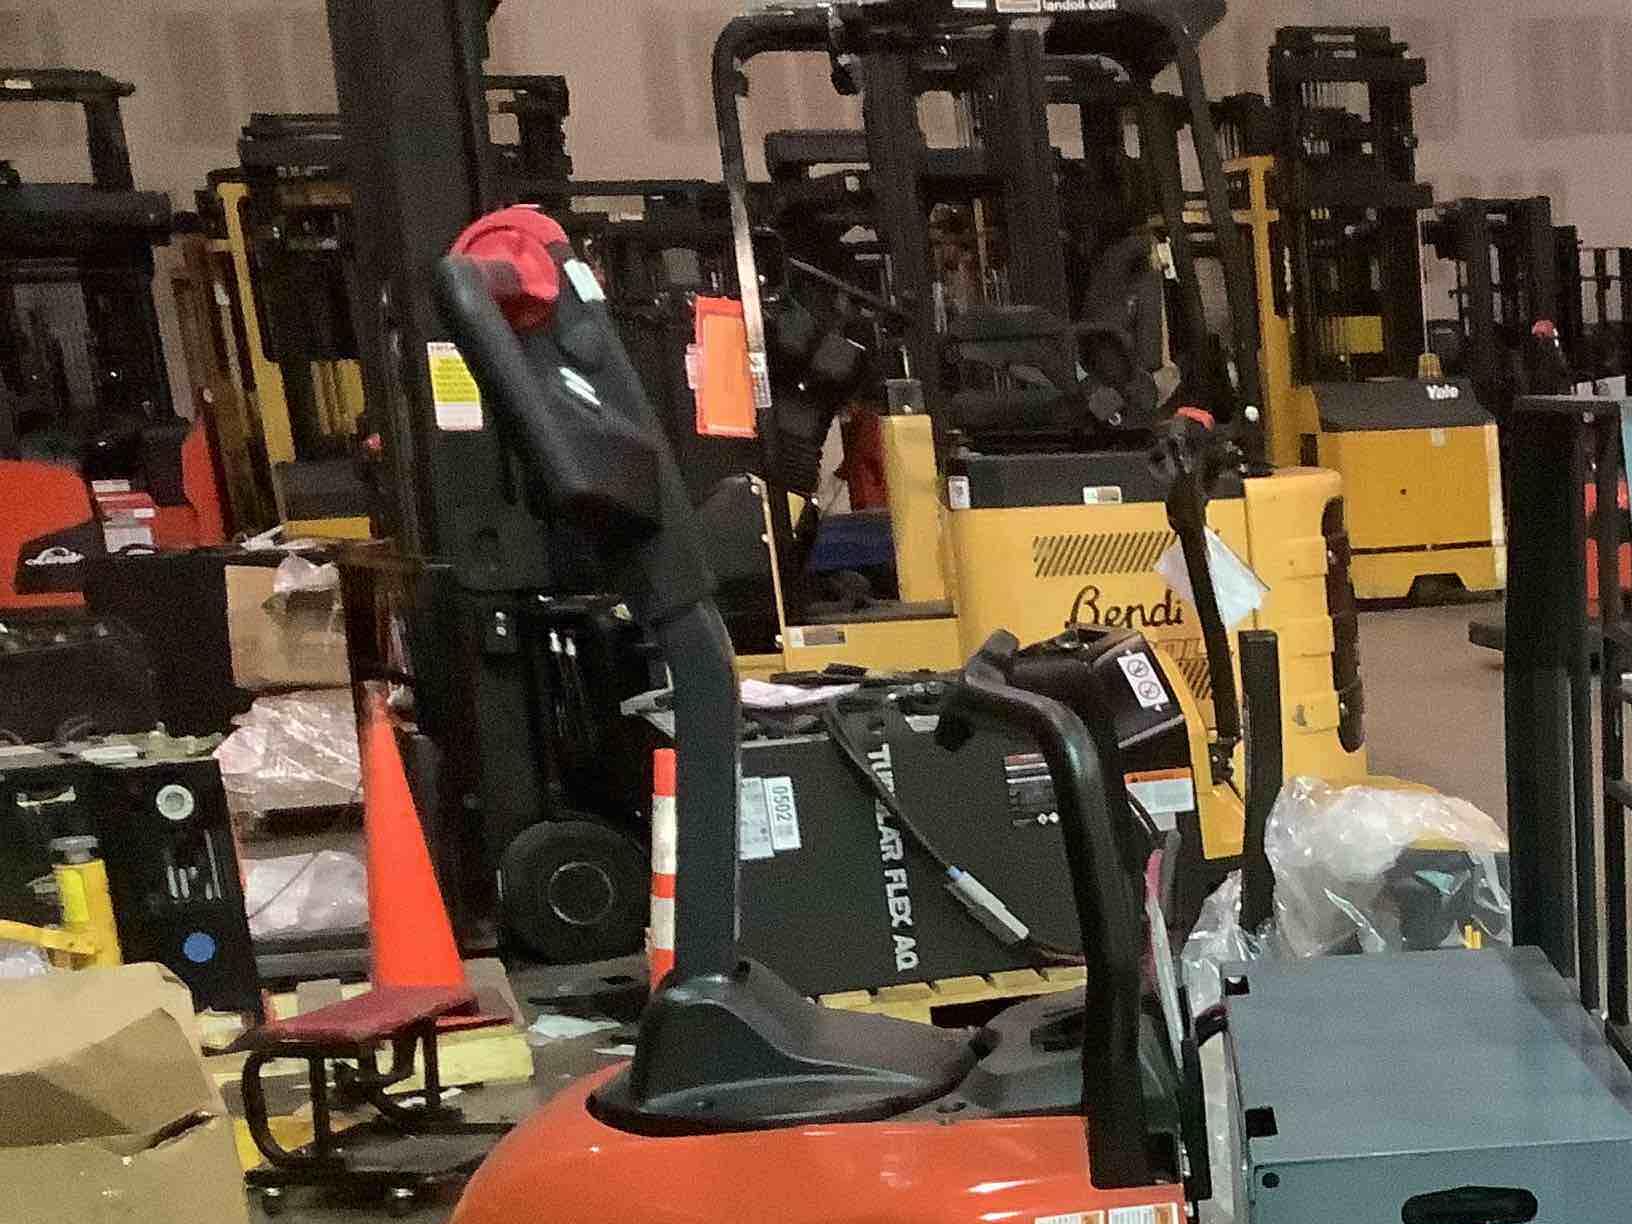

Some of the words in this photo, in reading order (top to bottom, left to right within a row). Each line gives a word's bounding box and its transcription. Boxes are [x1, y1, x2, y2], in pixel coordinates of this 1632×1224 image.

[1064, 584, 1184, 628] Bendi
[772, 785, 793, 822] 0502
[884, 867, 914, 928] FLEX
